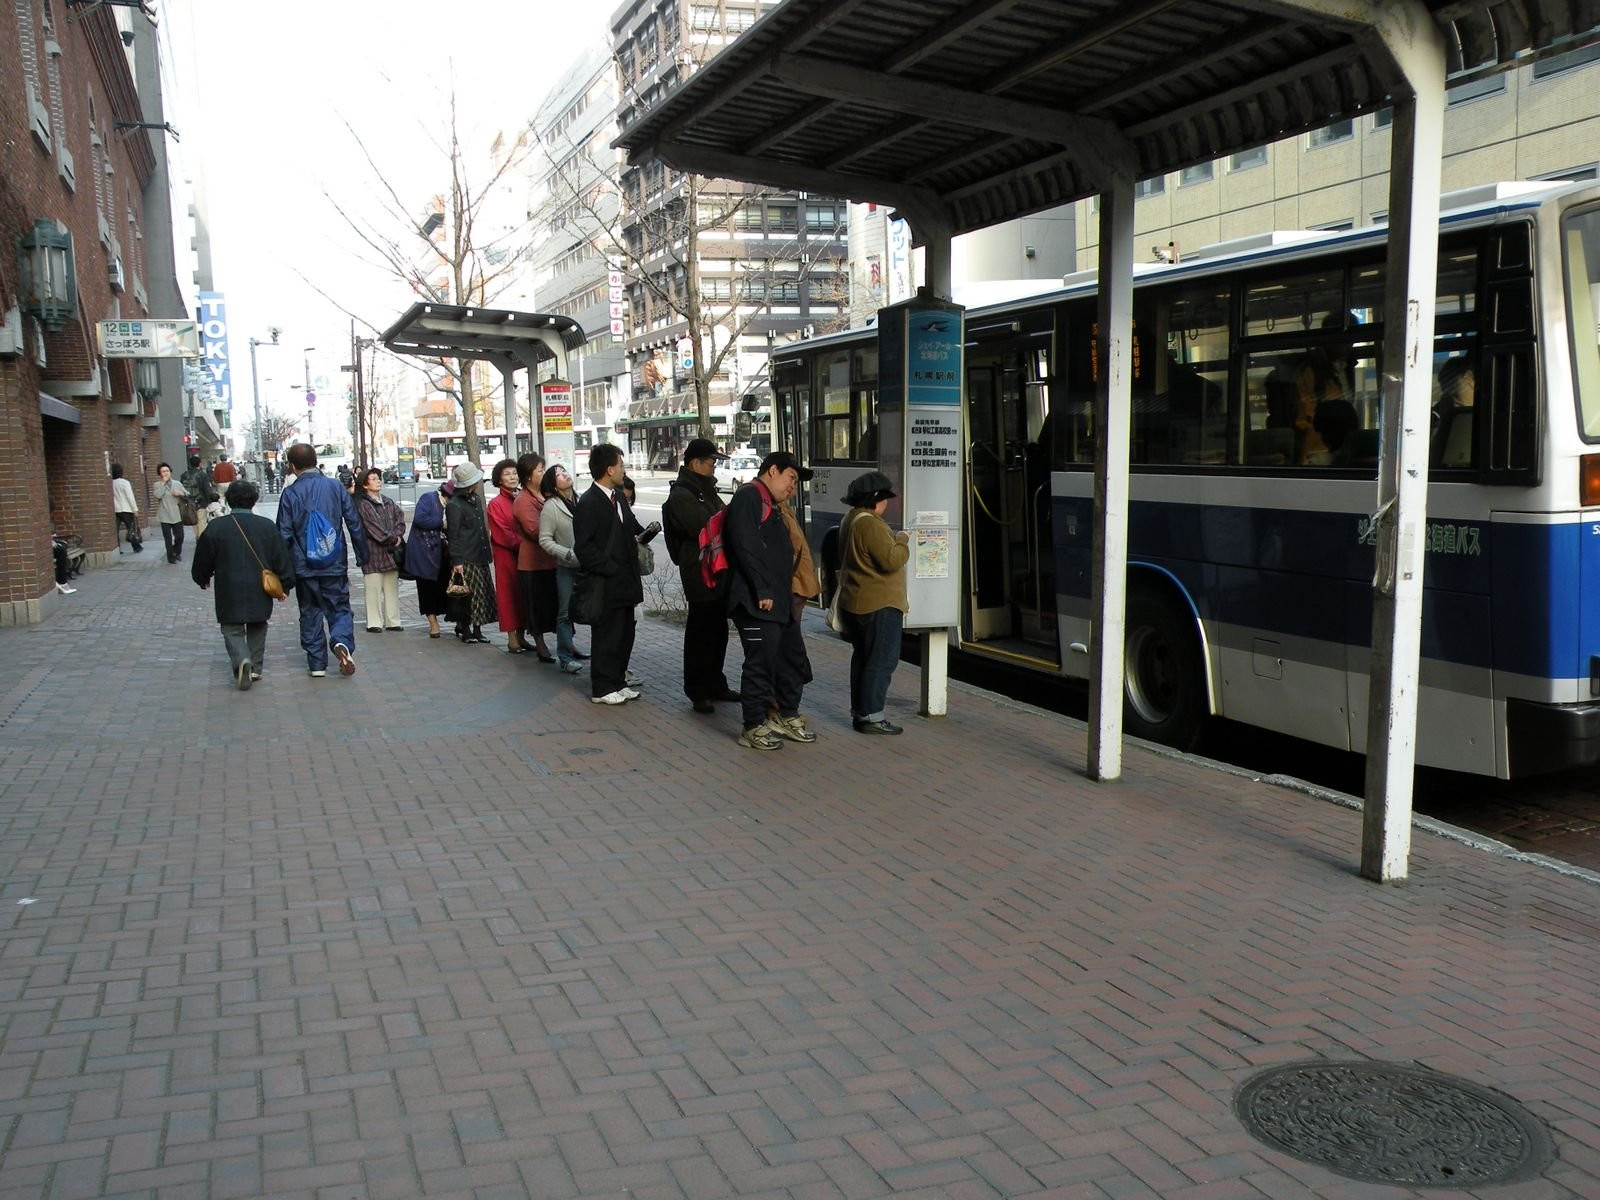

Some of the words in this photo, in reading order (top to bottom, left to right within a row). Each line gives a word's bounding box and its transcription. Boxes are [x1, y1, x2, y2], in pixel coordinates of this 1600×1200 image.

[104, 323, 117, 333] 12
[105, 339, 150, 349] さっぽろ駅
[201, 298, 230, 402] TOKYU
[914, 371, 954, 381] 札幌駅前
[1592, 524, 1600, 535] 5
